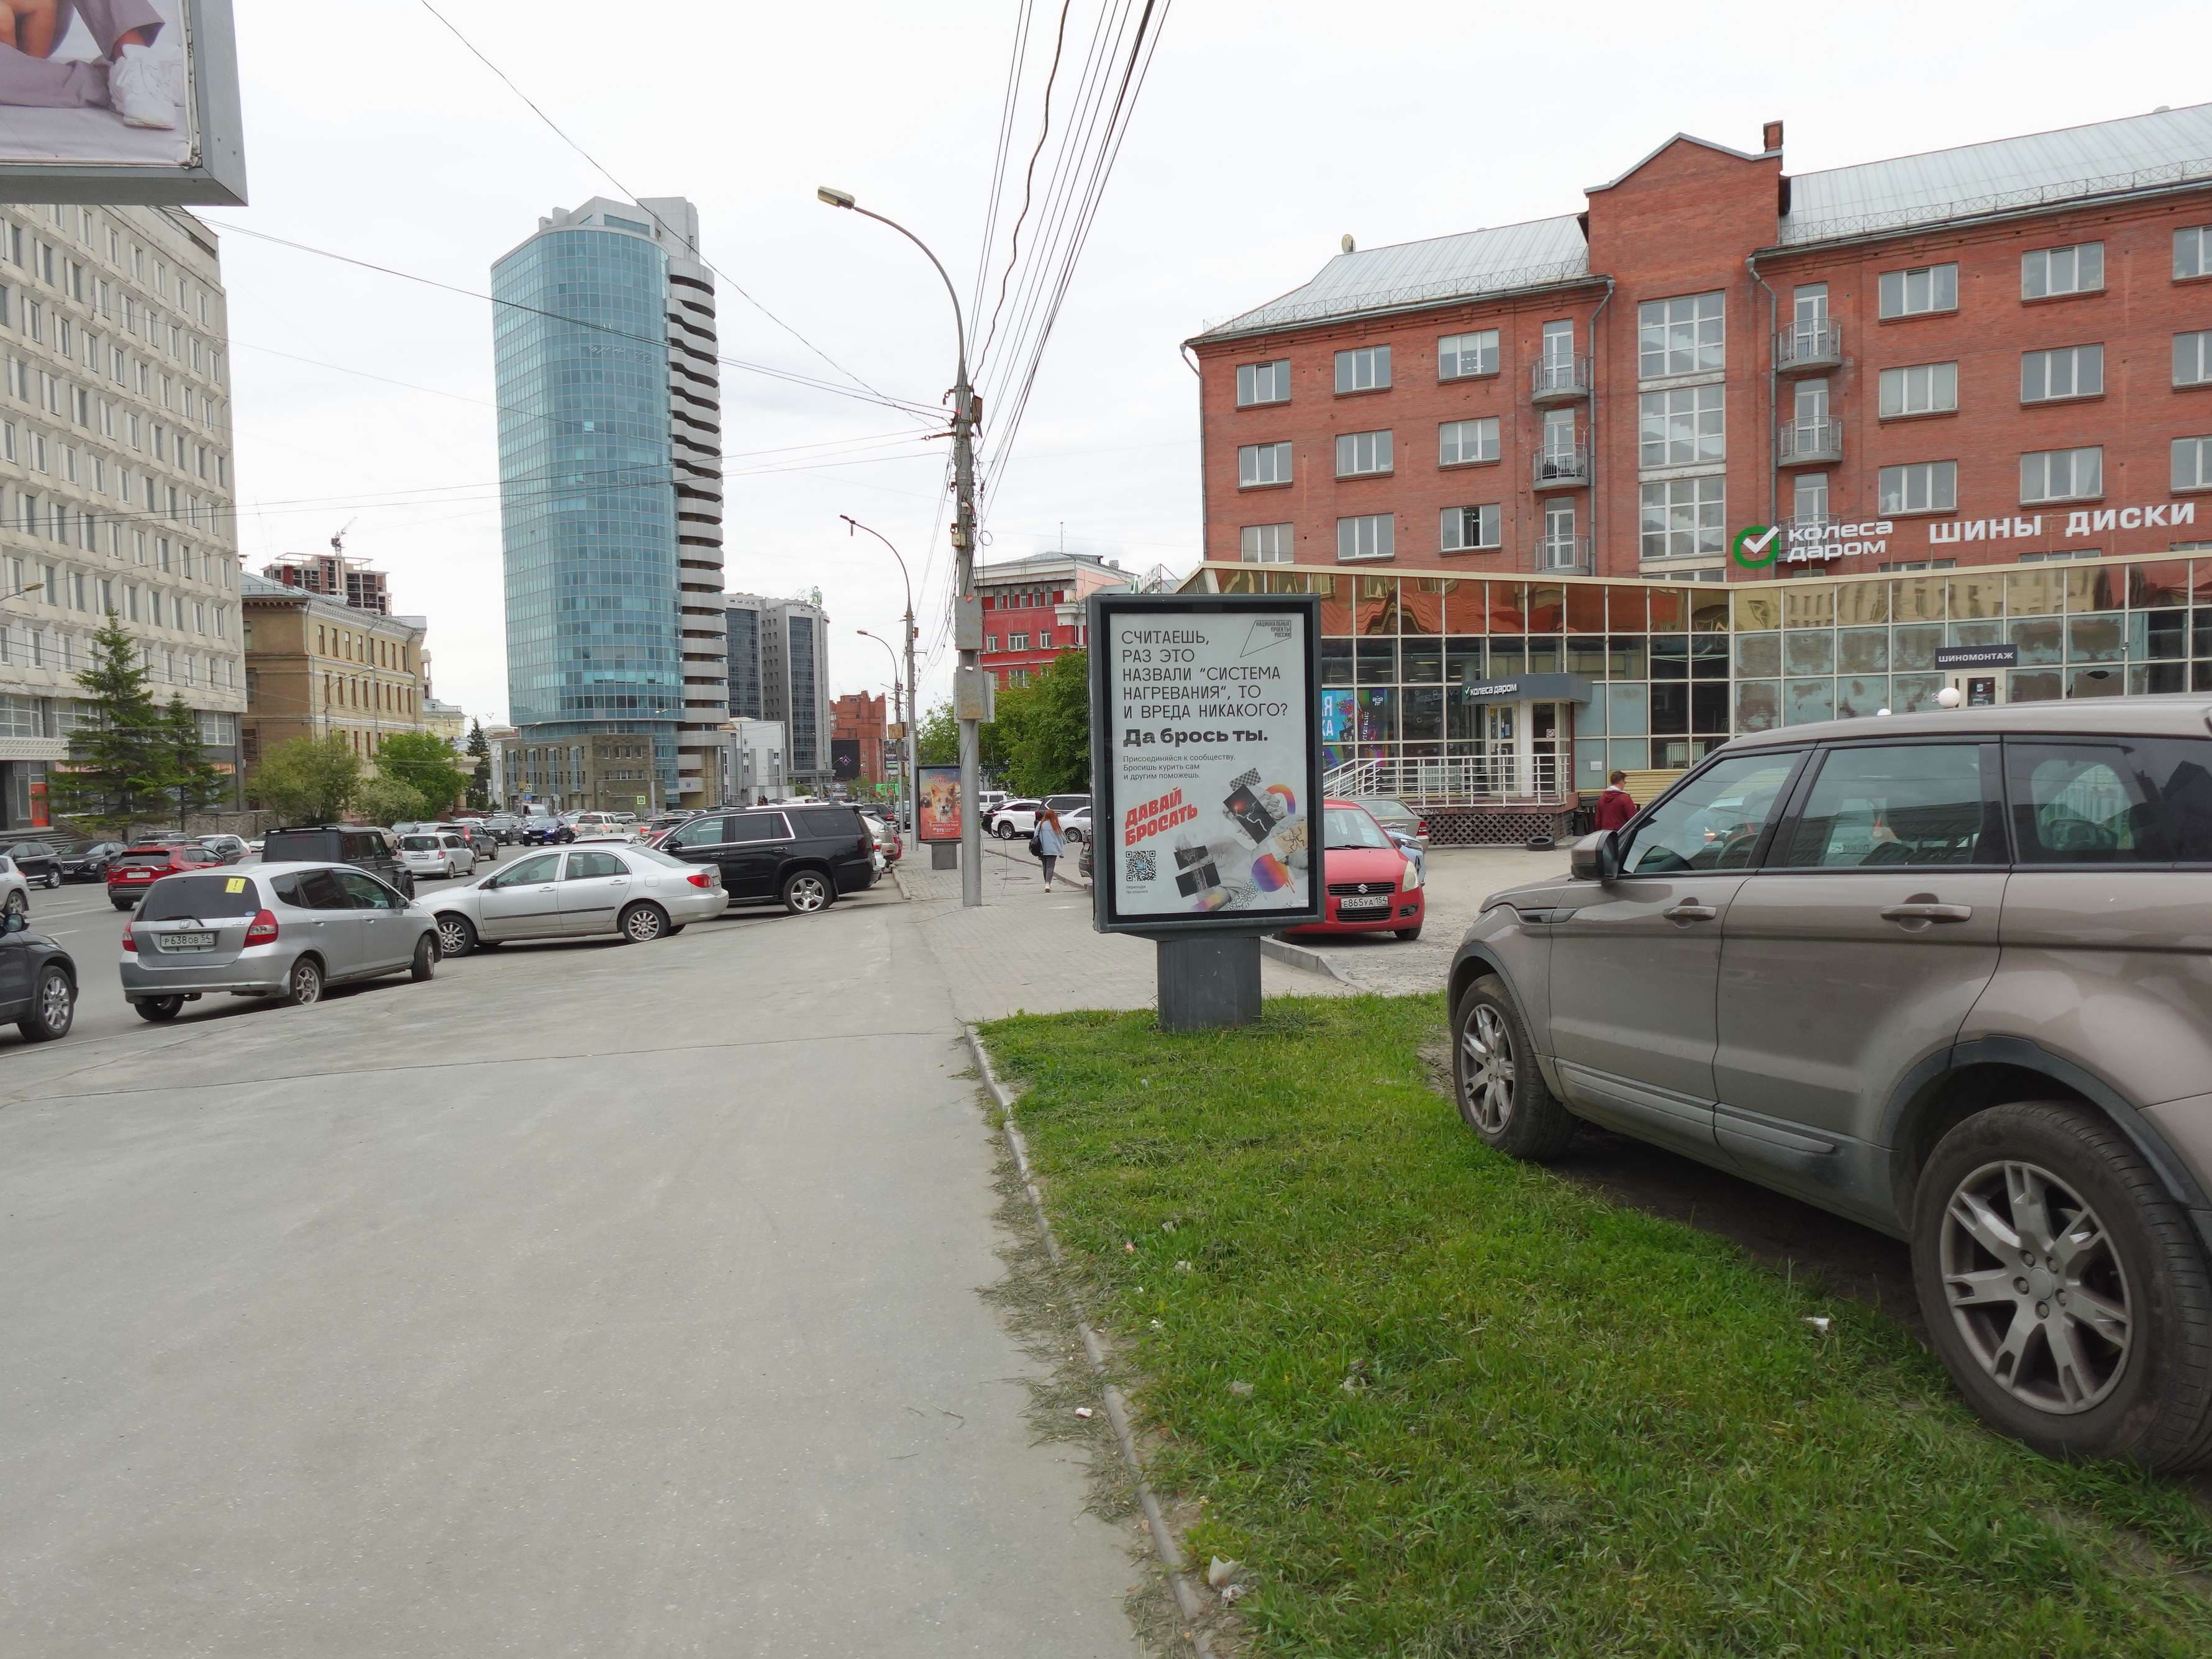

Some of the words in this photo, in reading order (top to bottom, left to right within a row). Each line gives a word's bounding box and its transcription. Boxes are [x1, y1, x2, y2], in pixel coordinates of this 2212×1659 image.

[1929, 515, 2041, 543] ШИНЫ
[2065, 502, 2195, 539] ДИСКИ
[1789, 520, 1893, 542] колеса
[1787, 540, 1886, 563] даром
[1121, 630, 1210, 645] СЧИТАЕШЬ,
[1122, 650, 1152, 663] РАЗ
[1160, 649, 1195, 663] ЭТО
[1938, 652, 2013, 662] ШИНОМОНТАЖ
[1123, 668, 1191, 681] НАЗВАЛИ
[1238, 685, 1261, 698] ТО
[1470, 686, 1493, 696] колеса
[1493, 683, 1517, 694] даром
[1124, 706, 1132, 719] И
[1141, 704, 1191, 720] ВРЕДА
[1199, 703, 1288, 717] НИКАКОГО?
[1123, 729, 1155, 747] Да
[1160, 728, 1228, 747] брось
[1232, 730, 1268, 742] ты.
[1123, 754, 1181, 763] Присоединяйся
[1190, 753, 1236, 761] сообществу.
[1123, 764, 1157, 772] Бросишь
[1159, 764, 1183, 772] курить
[1125, 786, 1182, 829] ДАВАЙ
[1125, 804, 1198, 847] БРОСАТЬ
